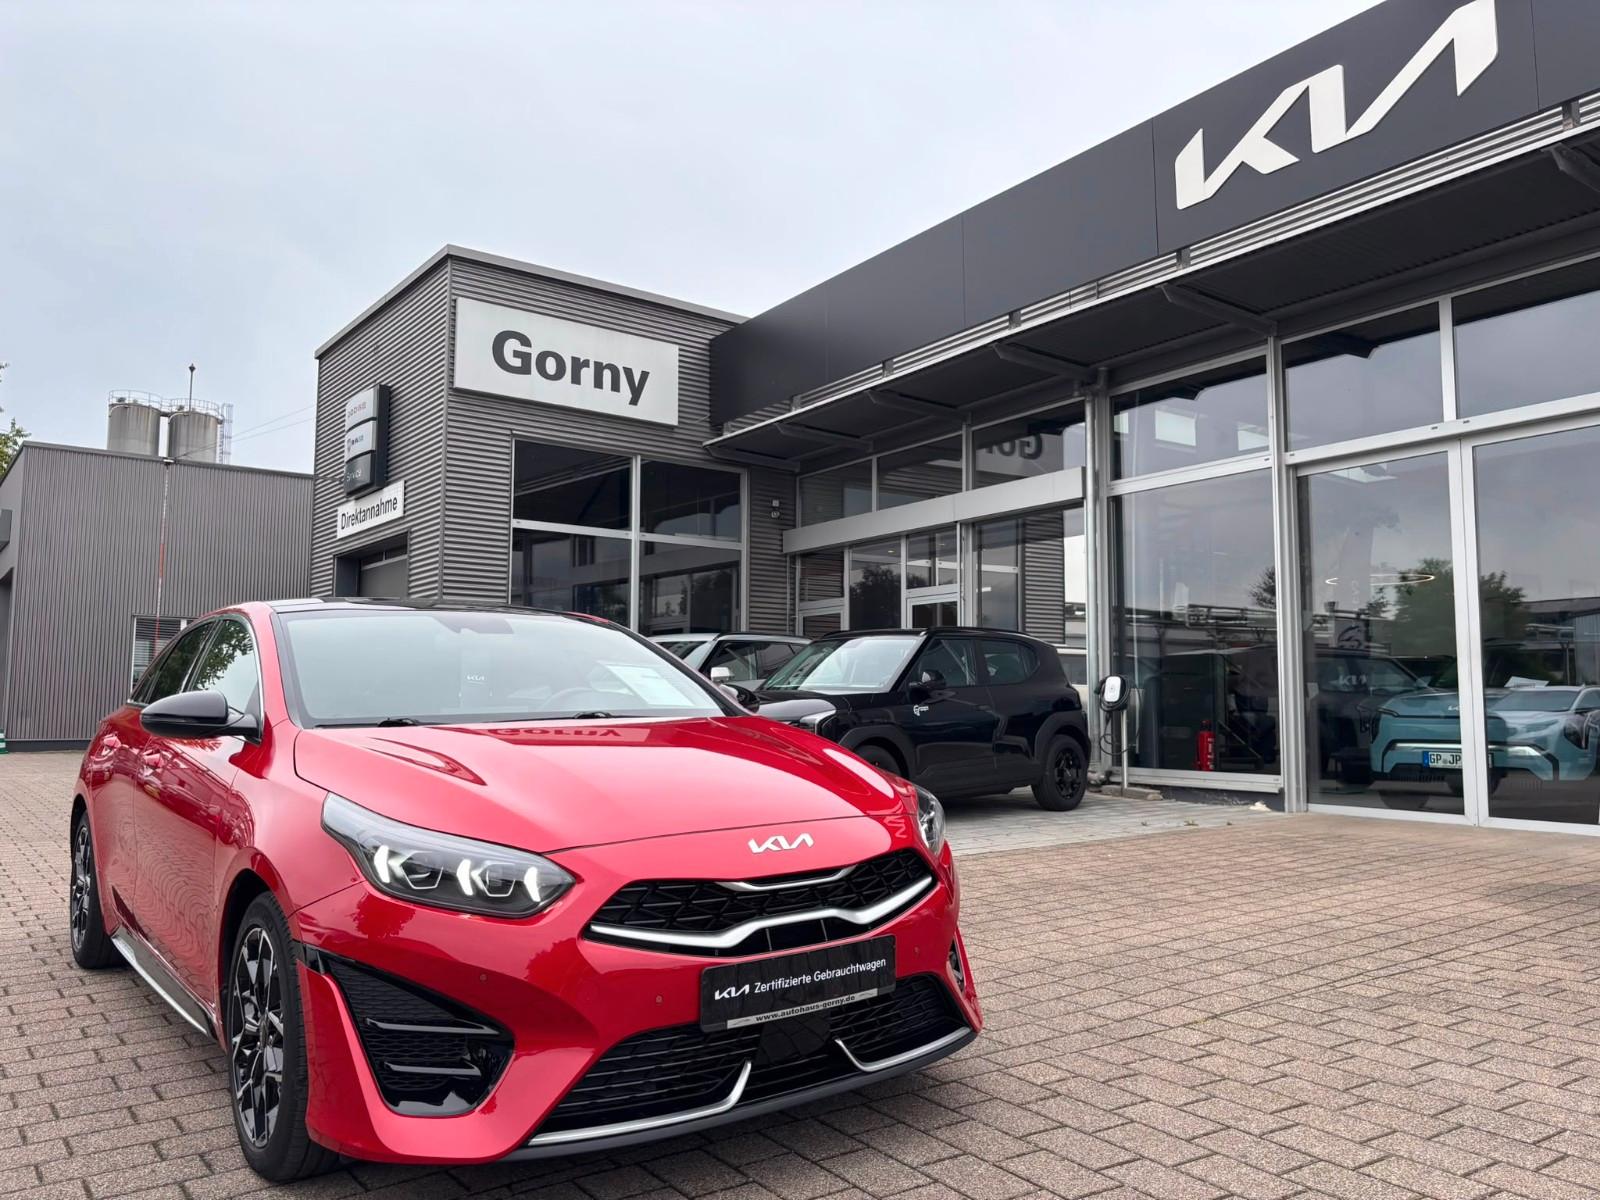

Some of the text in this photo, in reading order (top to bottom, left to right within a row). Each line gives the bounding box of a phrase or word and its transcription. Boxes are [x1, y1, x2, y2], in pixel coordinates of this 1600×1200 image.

[1174, 0, 1498, 210] KIA
[492, 330, 650, 406] Gorny
[341, 497, 398, 530] Direktannahme
[1429, 753, 1442, 764] GP
[748, 832, 815, 853] KIA
[714, 958, 886, 1000] KIA Zertifizierte Gebrauchtwagen
[755, 995, 856, 1022] www.autohaus-gorny.de
